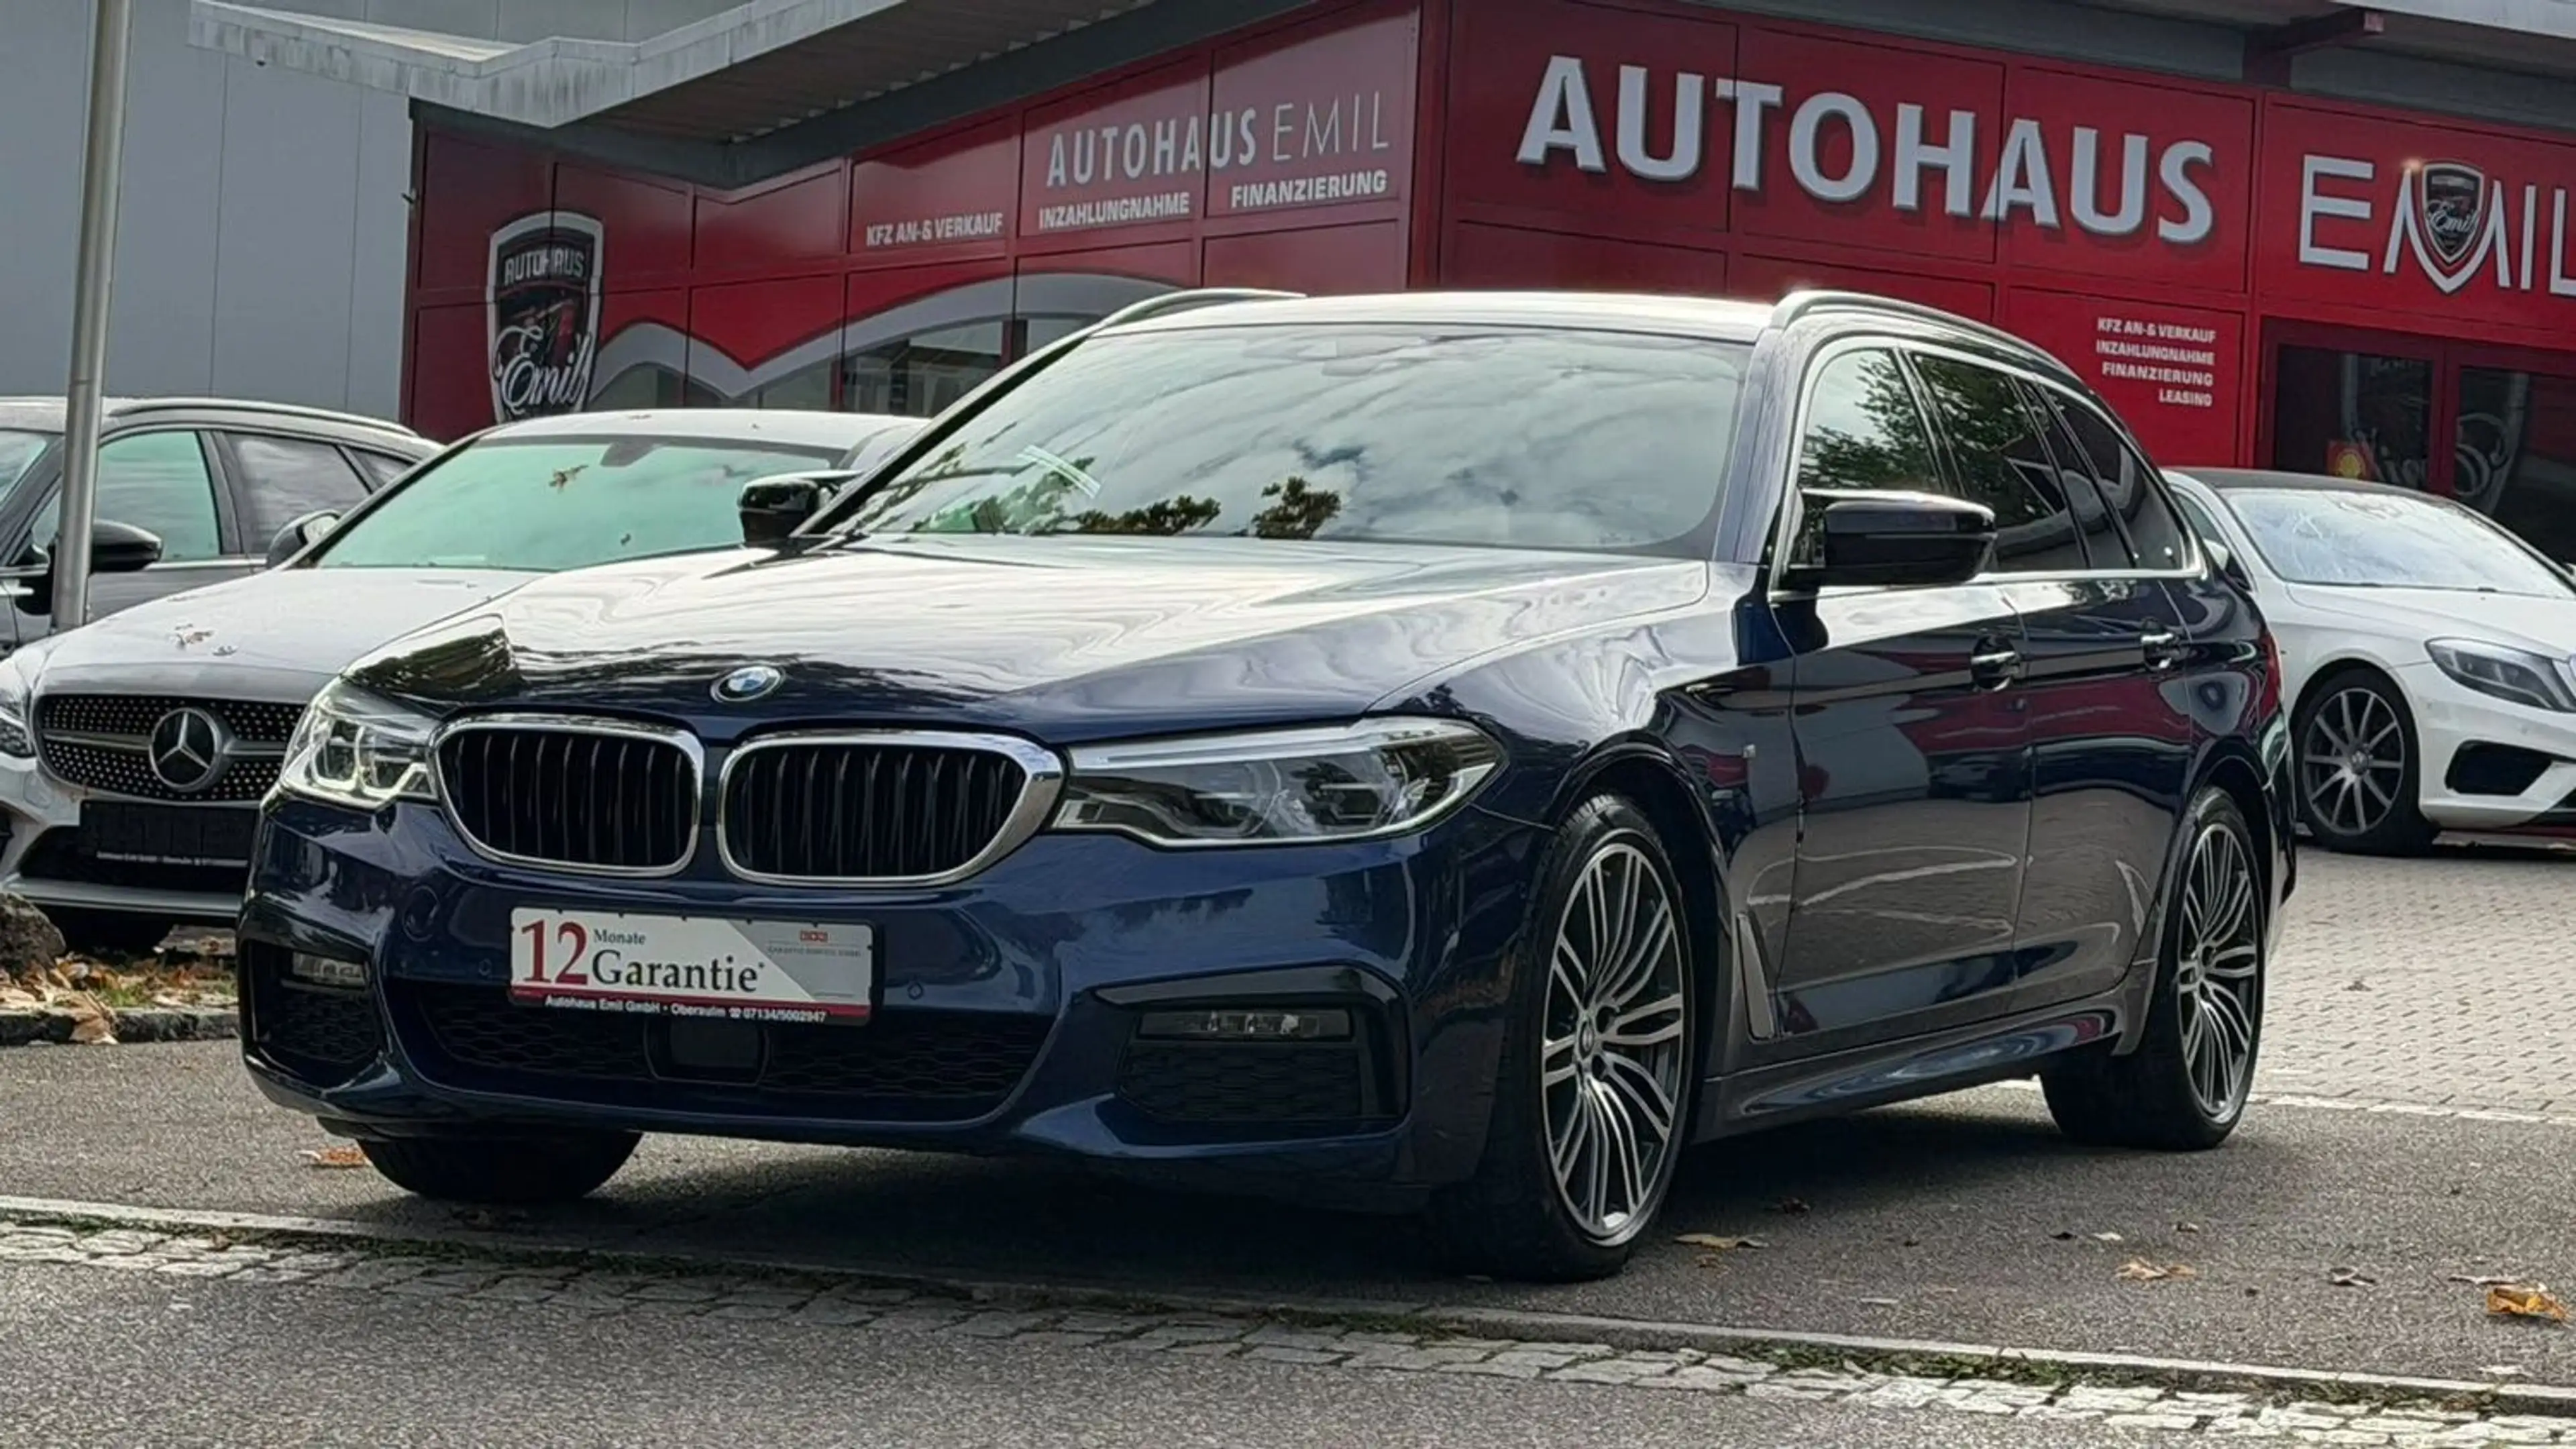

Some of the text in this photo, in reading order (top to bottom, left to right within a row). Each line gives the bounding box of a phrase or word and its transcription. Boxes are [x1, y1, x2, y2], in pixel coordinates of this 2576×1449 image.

[1046, 91, 1389, 188] AUTOHAUS EMIL
[1232, 170, 1387, 208] FINANZIERUNG
[1516, 55, 2576, 295] AUTOHAUS EMIL
[1039, 192, 1191, 230] INZAHLUNGNAHME
[866, 223, 894, 247] KFZ
[935, 212, 1004, 239] VERKAUF
[504, 248, 584, 286] AUTOHAUS
[2097, 317, 2123, 333] KFZ
[2158, 324, 2216, 343] VERKAUF
[492, 325, 592, 415] Emil
[2096, 339, 2214, 366] INZAHLUNGNAHME
[2102, 361, 2214, 387] FINANZIERUNG
[2159, 387, 2212, 407] LEASING
[521, 918, 589, 985] 12
[594, 928, 647, 946] Monate
[545, 994, 596, 1010] Autohaus
[598, 998, 624, 1012] Emil
[625, 1000, 661, 1014] GmbH
